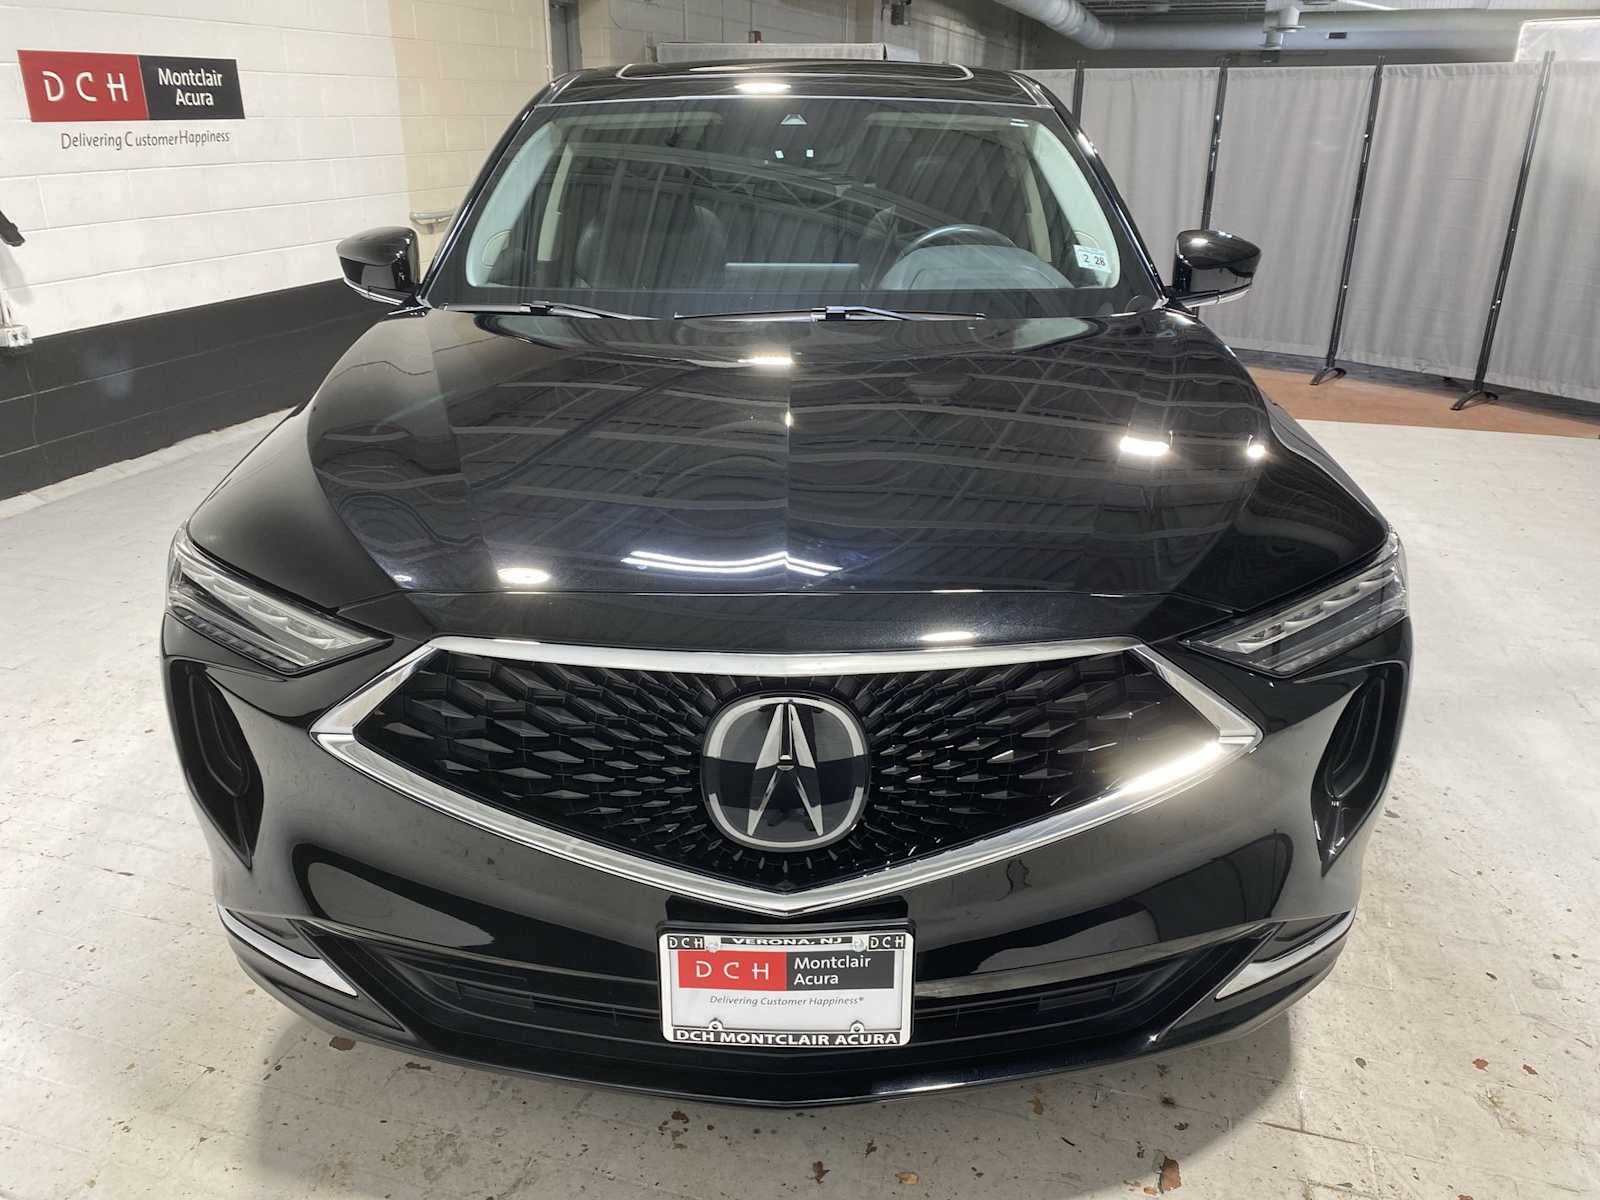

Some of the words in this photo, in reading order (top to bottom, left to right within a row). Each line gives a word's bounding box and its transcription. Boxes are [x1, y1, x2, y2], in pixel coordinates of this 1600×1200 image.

[158, 68, 223, 87] Montclair
[175, 89, 215, 106] Acura
[61, 132, 122, 151] Delivering
[179, 130, 230, 147] Happiness
[1094, 255, 1106, 266] 28
[732, 937, 815, 945] VERONA,
[820, 937, 843, 945] NJ
[793, 955, 872, 970] Montclair
[793, 973, 840, 986] Acura
[709, 995, 759, 1007] Delivering
[760, 996, 807, 1007] Customer
[675, 1029, 715, 1043] DCH
[720, 1031, 829, 1046] MONTCLAIR
[834, 1032, 898, 1046] ACURA
